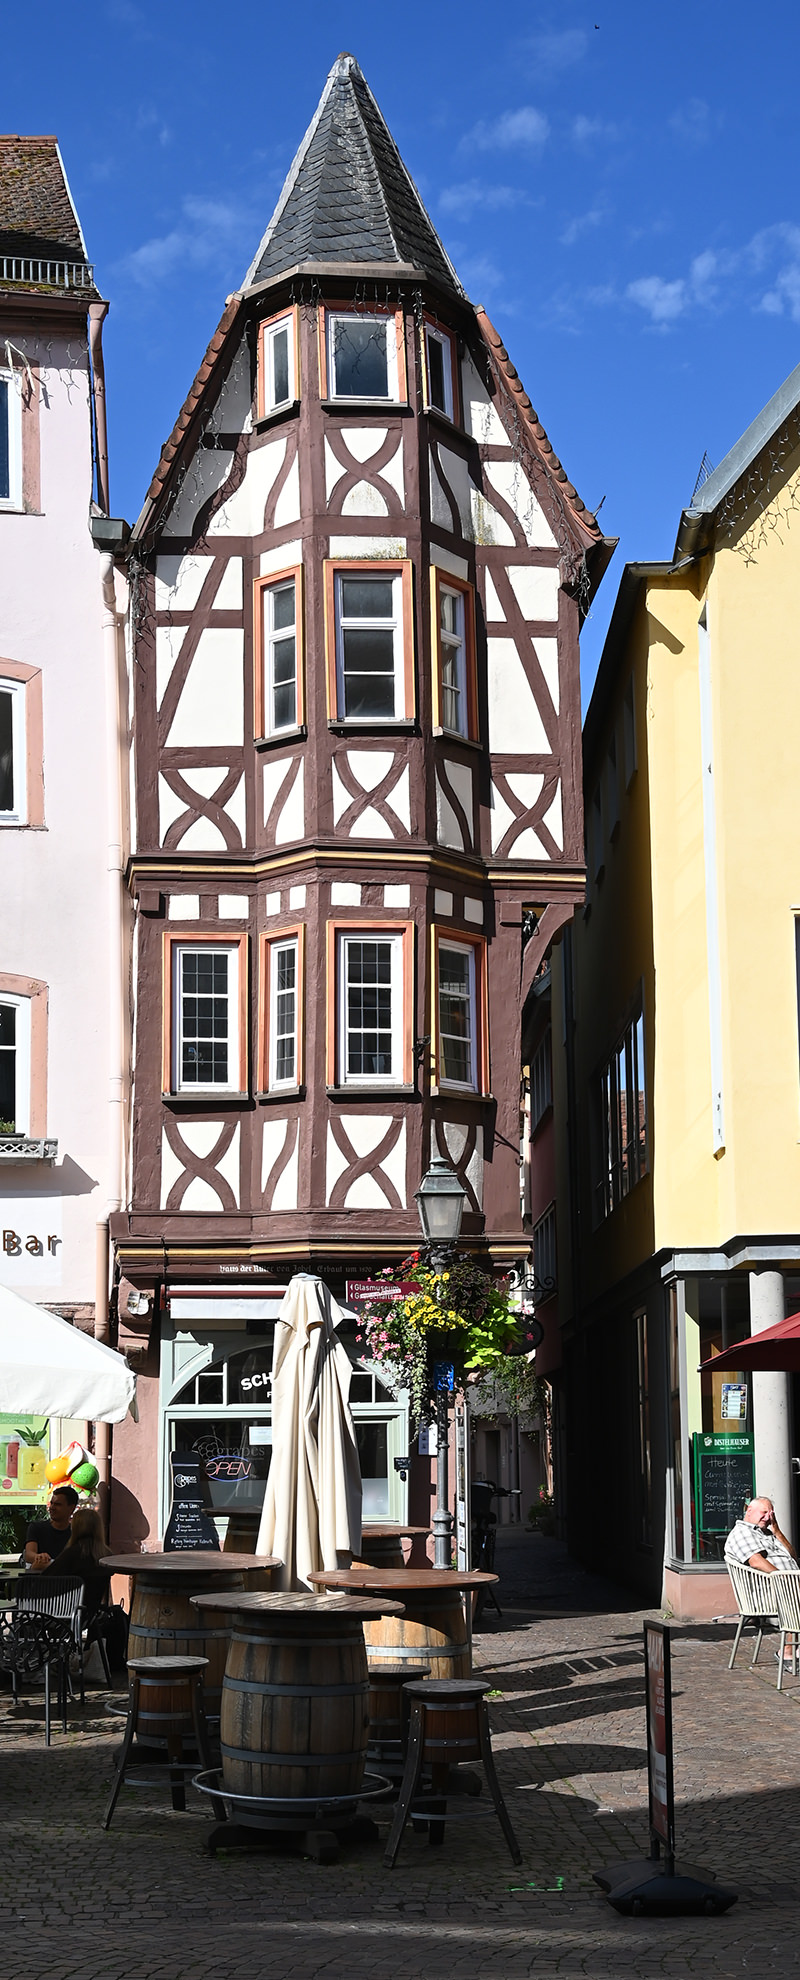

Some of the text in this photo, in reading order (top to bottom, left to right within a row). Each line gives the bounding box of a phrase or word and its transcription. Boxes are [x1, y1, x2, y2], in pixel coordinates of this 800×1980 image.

[3, 1230, 57, 1251] Bar
[240, 1264, 253, 1272] der
[707, 1456, 738, 1467] Heute
[205, 1462, 252, 1476] OPEN
